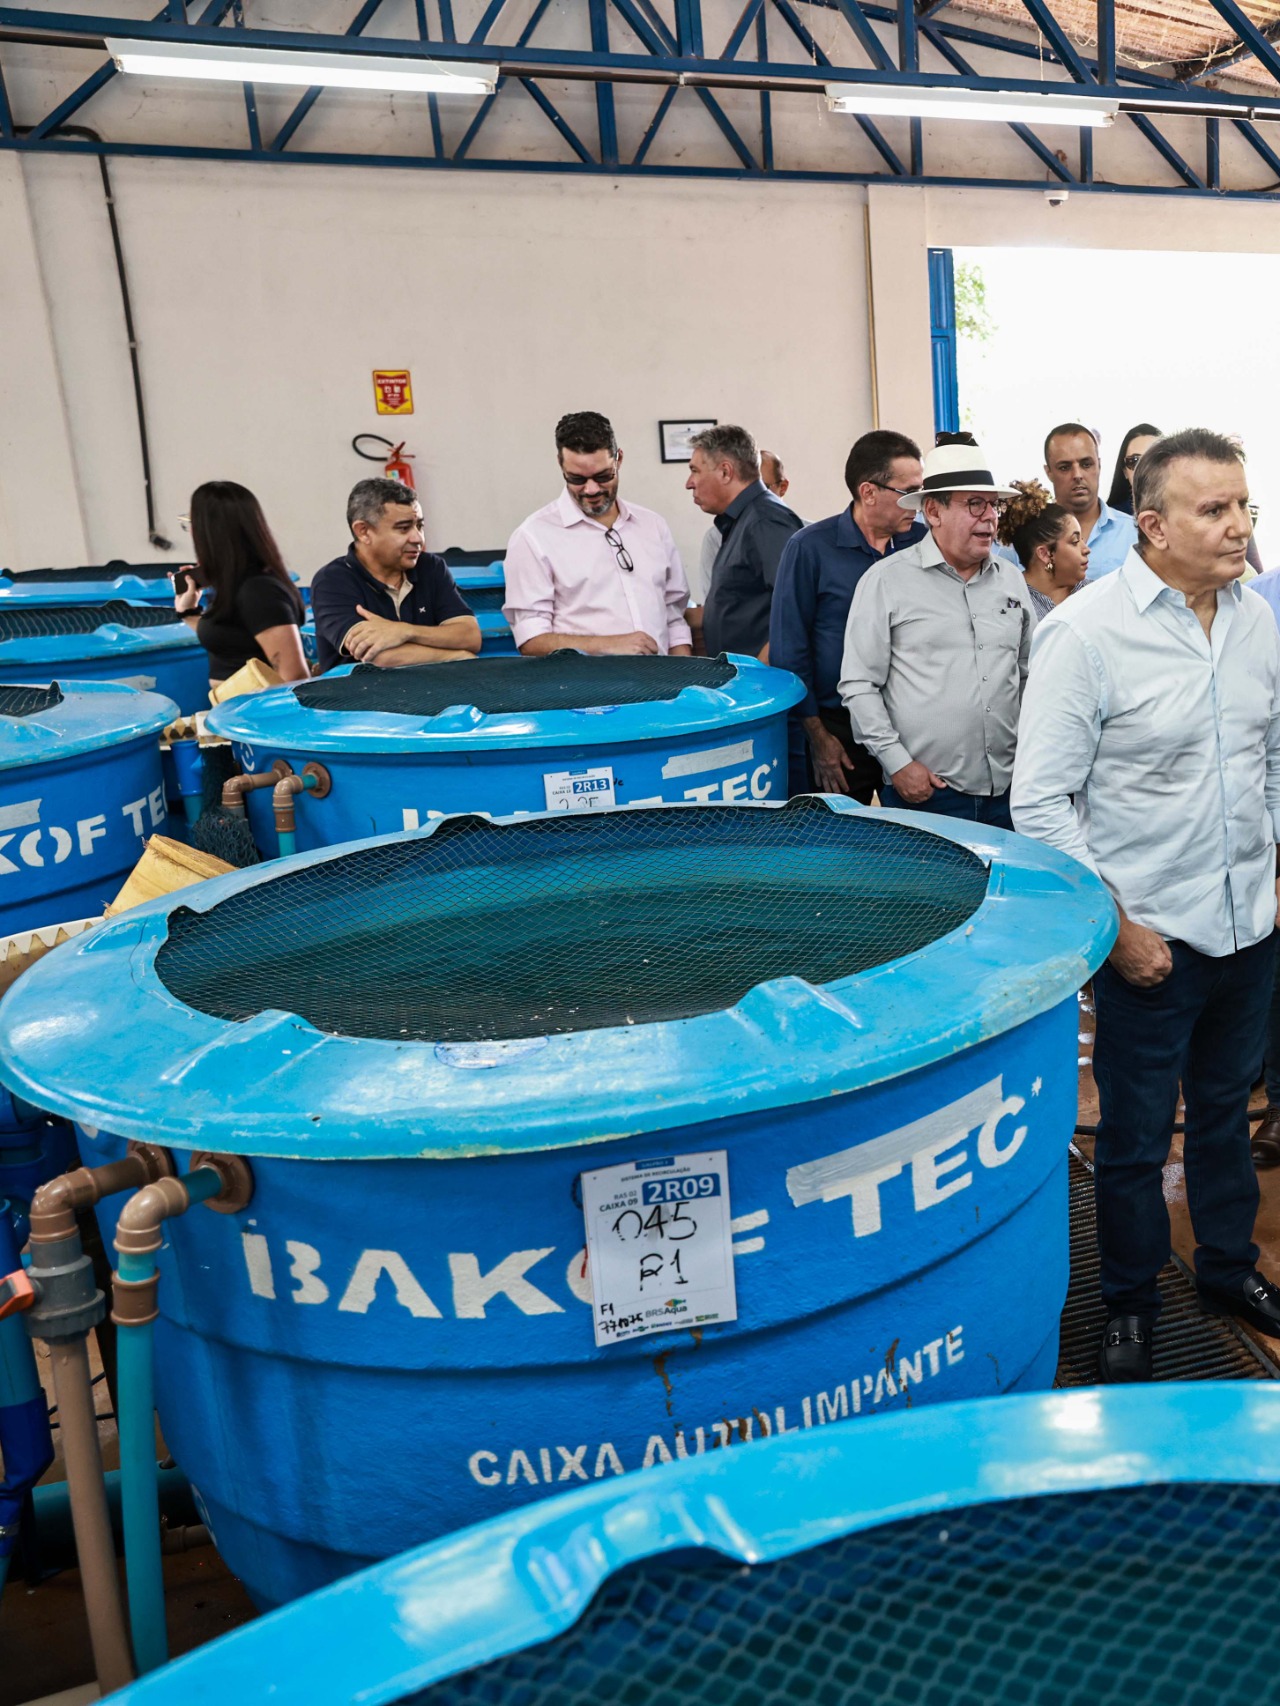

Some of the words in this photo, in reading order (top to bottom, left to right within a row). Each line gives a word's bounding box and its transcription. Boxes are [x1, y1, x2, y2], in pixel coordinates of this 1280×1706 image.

[575, 779, 607, 793] 2R13
[122, 778, 168, 837] TE
[621, 1173, 643, 1182] SISTEMA
[652, 1167, 691, 1177] RECIRCULAÇÃO
[823, 1096, 1028, 1238] TEC
[614, 1191, 628, 1200] RAS
[648, 1176, 714, 1203] 2R09
[599, 1201, 627, 1212] CAIXA
[628, 1198, 639, 1206] 09
[612, 1201, 698, 1241] 045
[645, 1306, 688, 1318] BRSAqua
[468, 1441, 625, 1486] CAIXA
[642, 1325, 965, 1469] AUTOLIMPANTE
